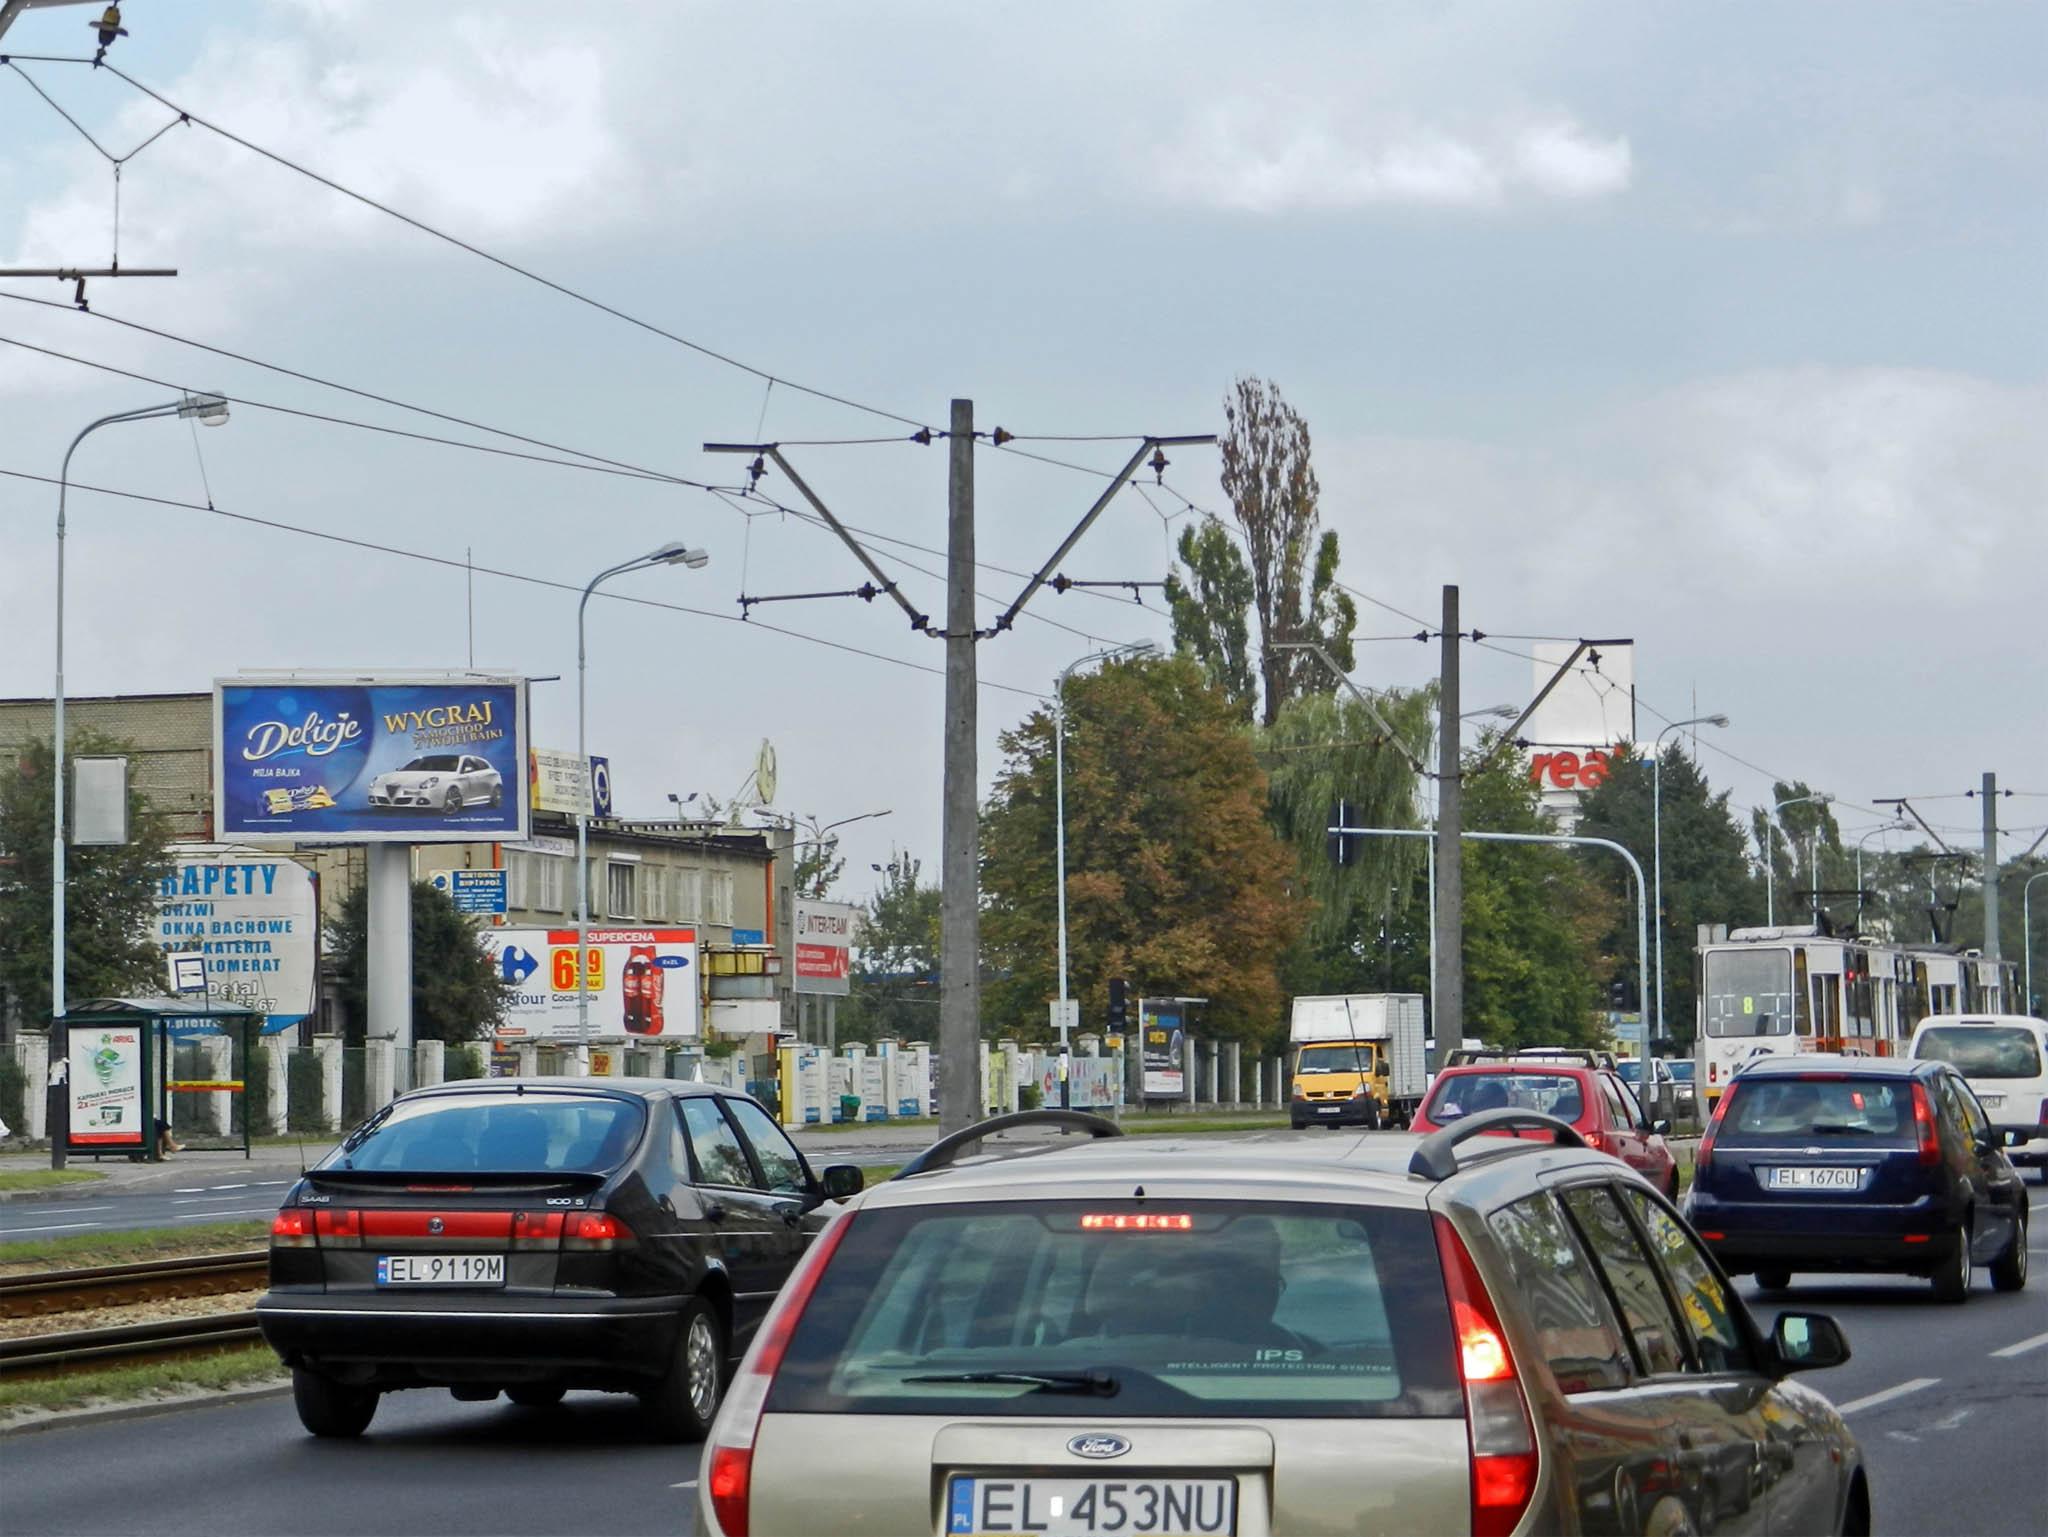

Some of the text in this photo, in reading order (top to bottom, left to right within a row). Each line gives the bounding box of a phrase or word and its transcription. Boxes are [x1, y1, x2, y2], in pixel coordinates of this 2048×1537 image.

[383, 700, 494, 734] WYGRAJ
[242, 711, 362, 760] Delicje
[470, 728, 503, 742] BAJKI
[1528, 742, 1624, 789] rea
[162, 921, 205, 935] OKNA
[586, 932, 656, 943] SUPERCENA
[208, 958, 281, 973] LOMERAT
[207, 980, 259, 996] Detal
[551, 992, 599, 1003] Coca-ola
[258, 1000, 277, 1013] 67
[1743, 996, 1754, 1015] 8
[1779, 1169, 1856, 1185] EL 167GU
[546, 1198, 584, 1206] 900 S
[391, 1258, 501, 1281] EL 9119M
[1255, 1349, 1304, 1362] IPS
[1081, 1437, 1119, 1454] Ford
[981, 1483, 1225, 1532] EL 453NU
[952, 1514, 971, 1527] PL
